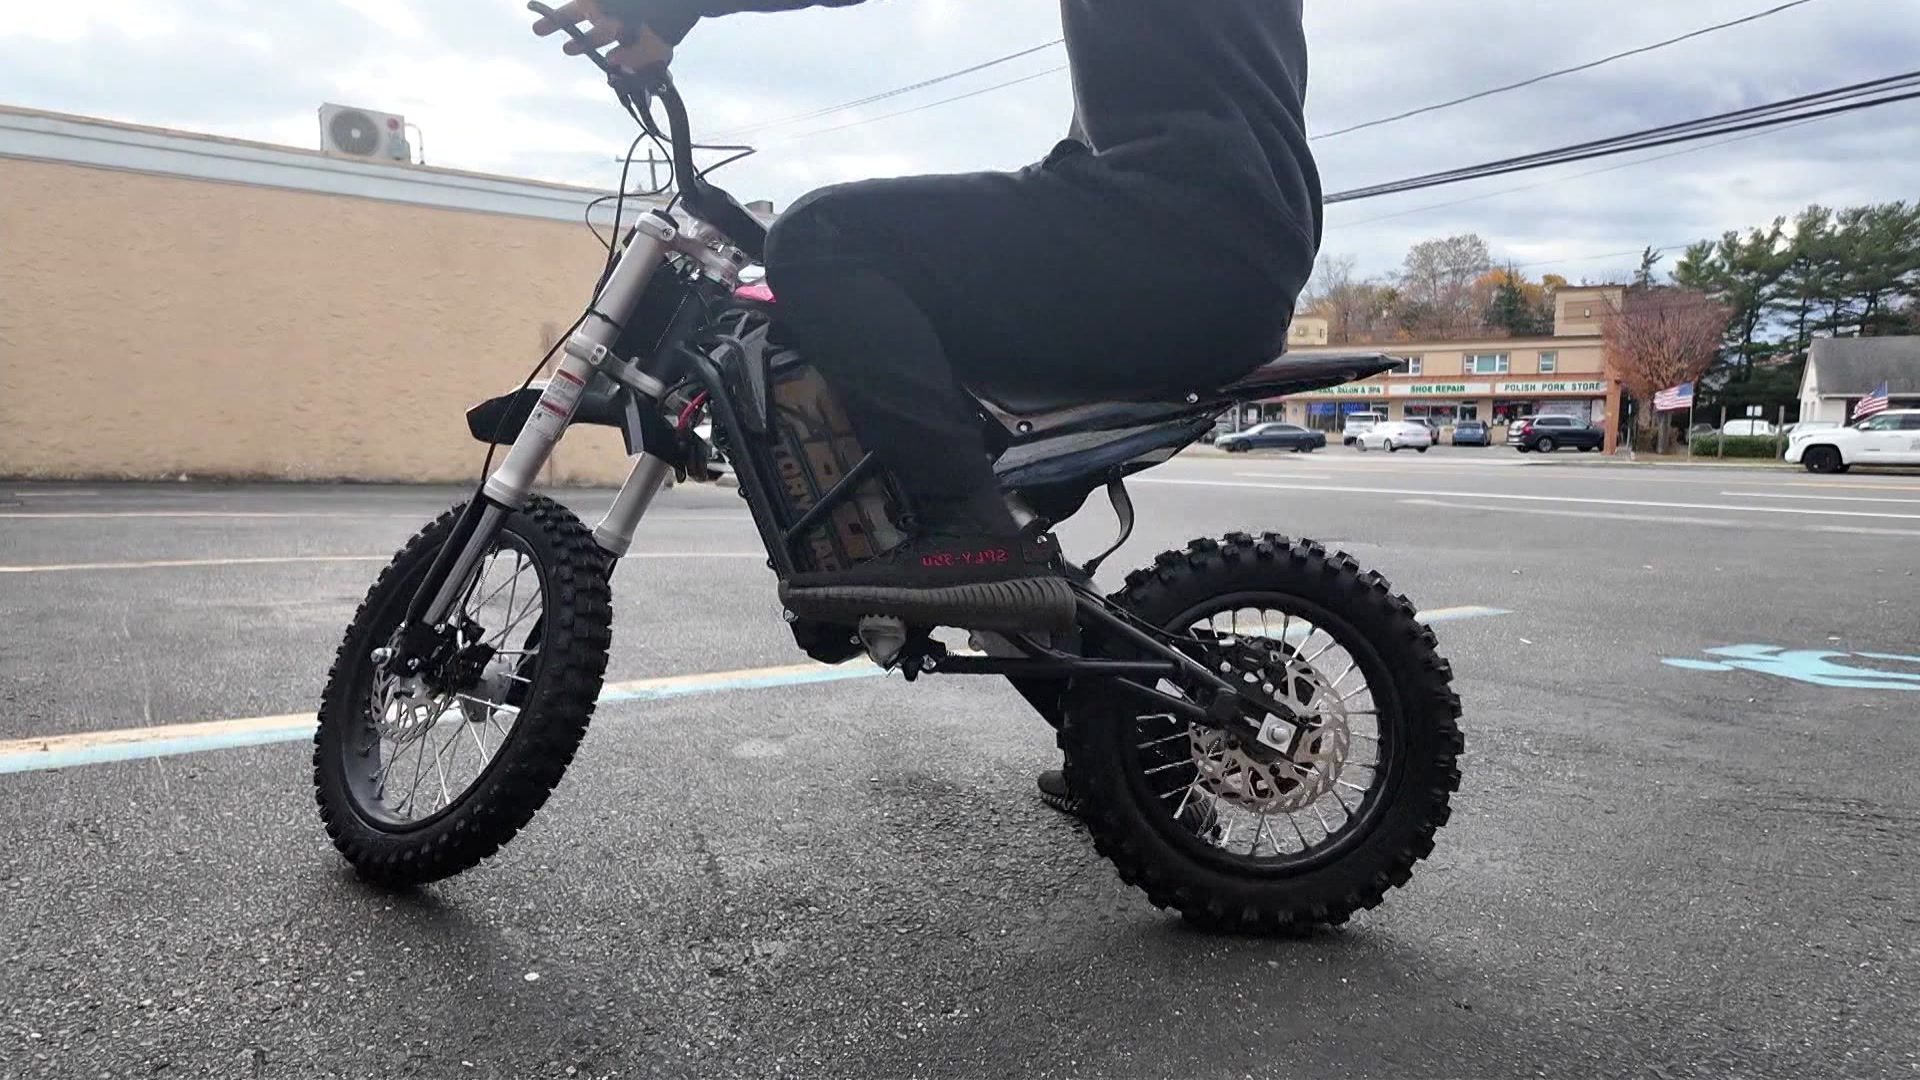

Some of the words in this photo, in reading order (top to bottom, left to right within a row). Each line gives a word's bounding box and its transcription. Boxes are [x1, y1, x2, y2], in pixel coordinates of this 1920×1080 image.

[1410, 384, 1432, 393] SHOE
[1435, 384, 1466, 392] REPAIR
[1504, 383, 1536, 392] POLISH
[1541, 383, 1566, 391] PORK
[1571, 382, 1601, 391] STORE
